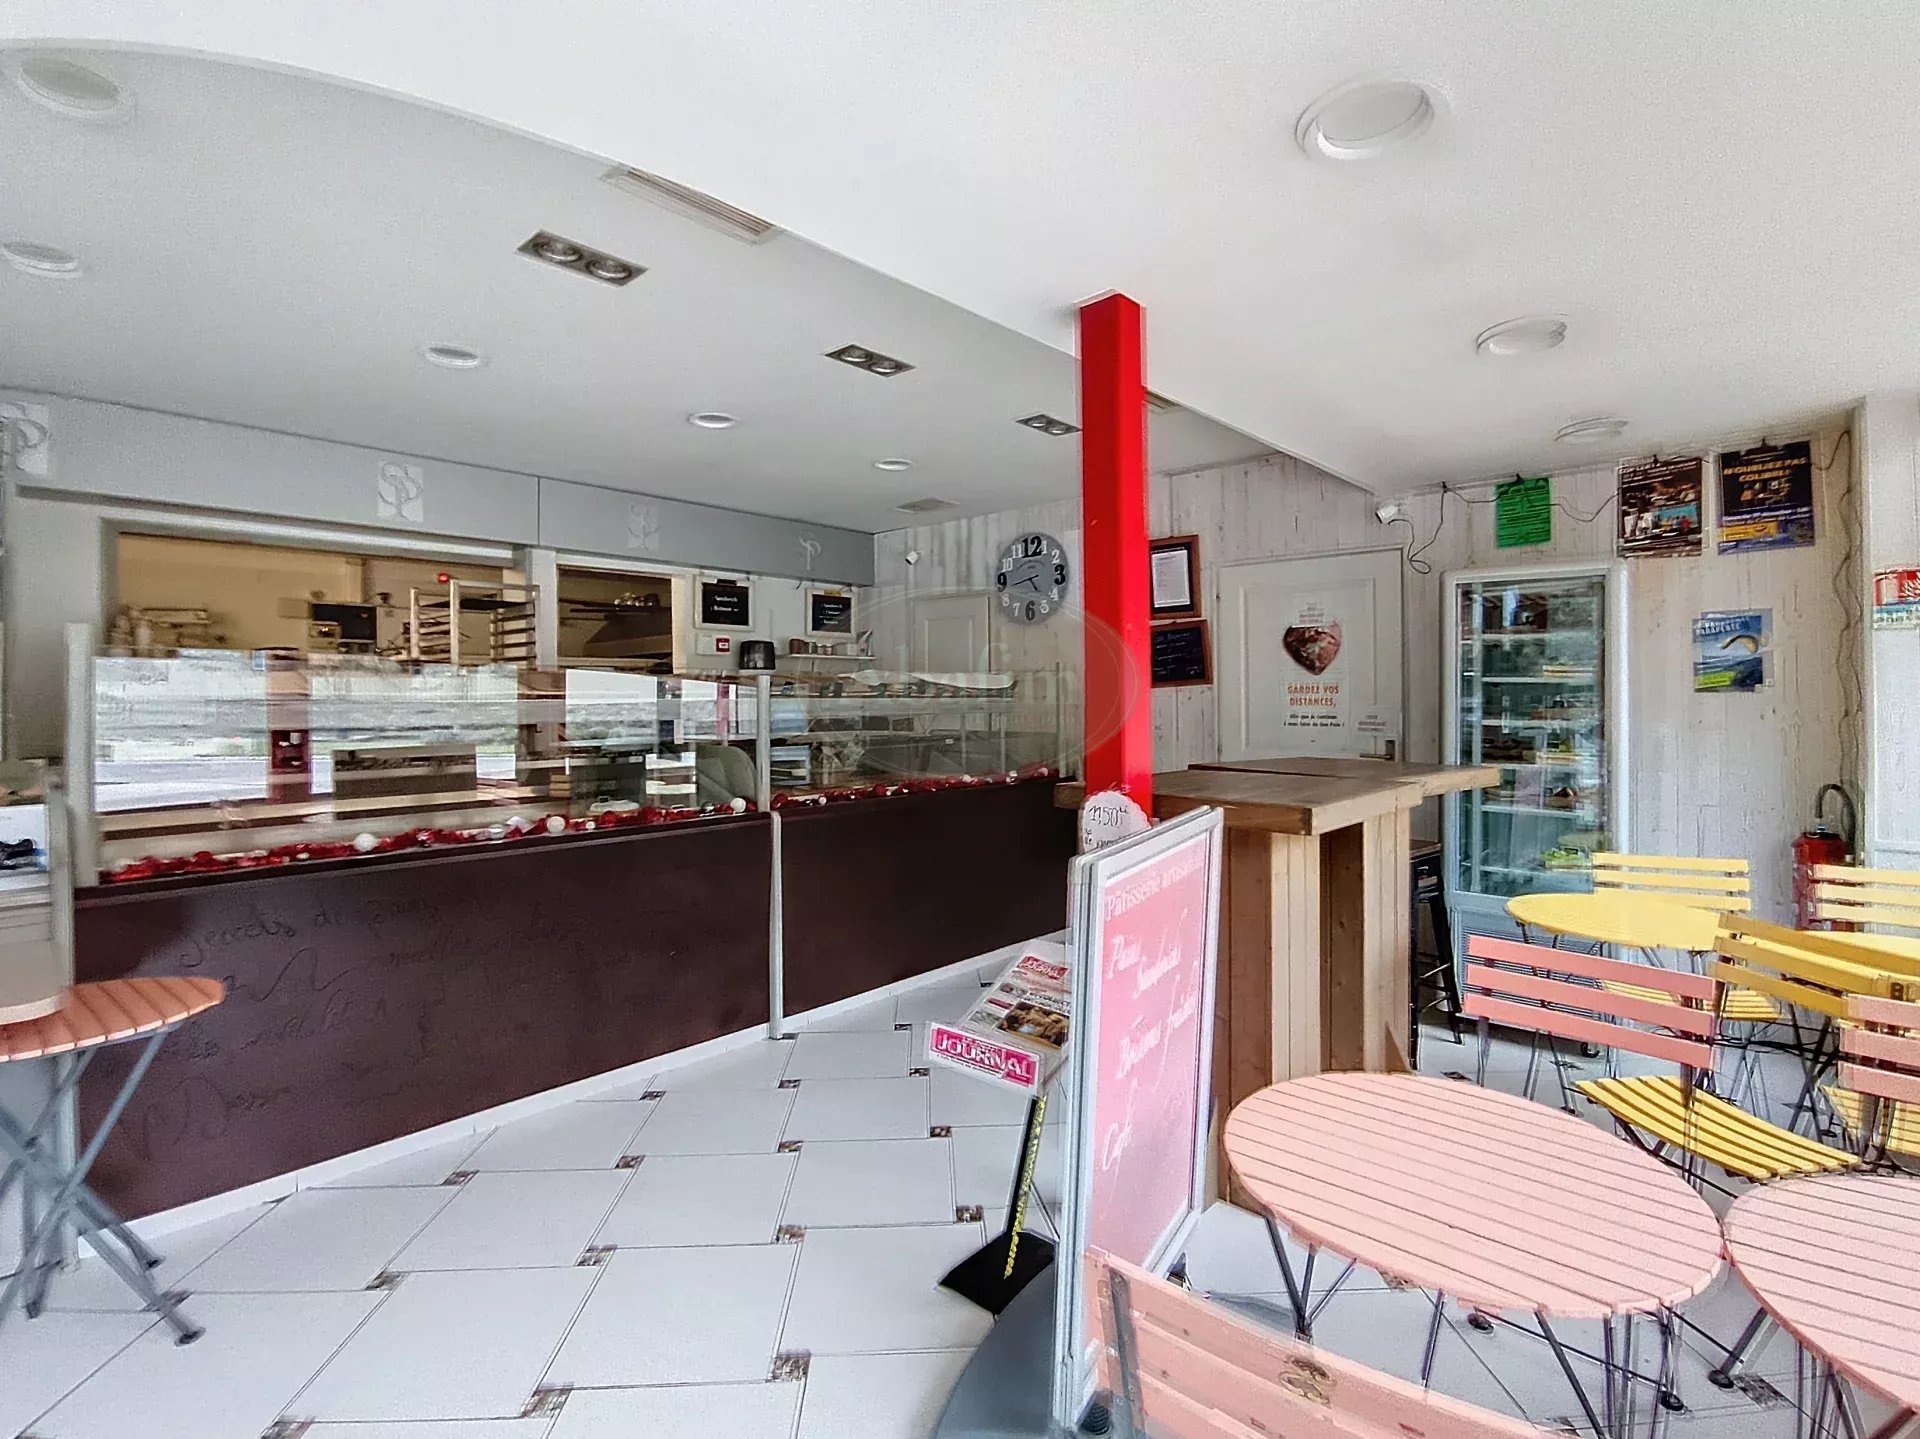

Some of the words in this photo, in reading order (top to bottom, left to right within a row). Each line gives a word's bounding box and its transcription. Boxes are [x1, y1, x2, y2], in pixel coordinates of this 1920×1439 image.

[1012, 544, 1023, 558] 11
[1022, 536, 1042, 558] 12
[1041, 540, 1047, 554] 1
[1051, 549, 1060, 564] 2
[1002, 558, 1013, 572] 10
[1054, 564, 1066, 585] 3
[997, 572, 1007, 592] 9
[1002, 593, 1010, 607] 8
[1050, 587, 1059, 601] 4
[1013, 603, 1020, 616] 7
[1025, 600, 1036, 621] 6
[1040, 600, 1049, 613] 5
[1287, 684, 1321, 695] GARDEZ
[1323, 685, 1340, 695] VOS
